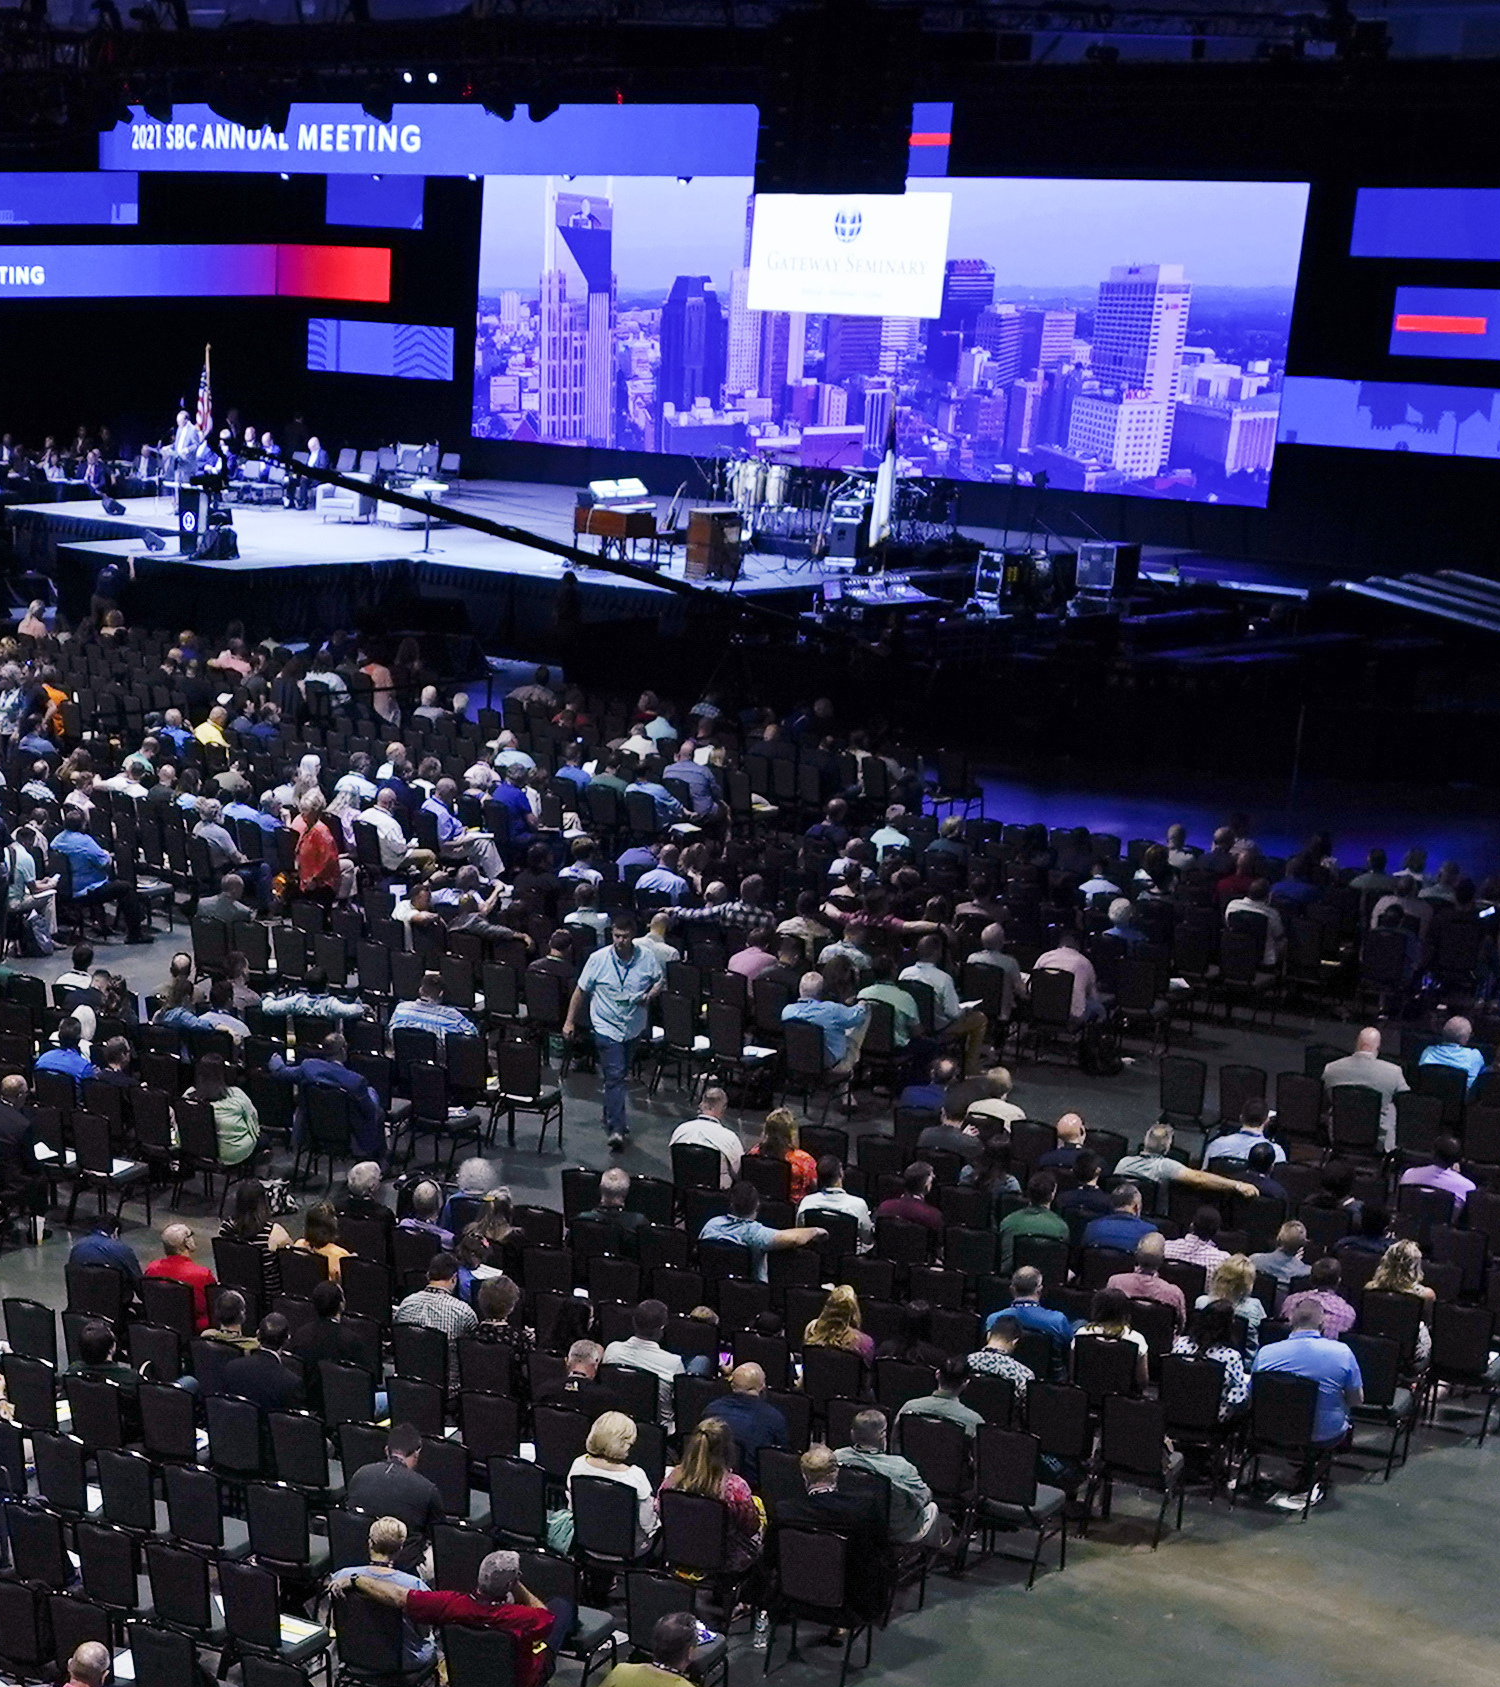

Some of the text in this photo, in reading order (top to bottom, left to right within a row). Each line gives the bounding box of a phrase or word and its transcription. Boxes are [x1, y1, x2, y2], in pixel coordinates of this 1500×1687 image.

[131, 123, 422, 153] 2021 SBC ANNUAL MEETING
[767, 250, 928, 275] GATEWAY SEMINARY
